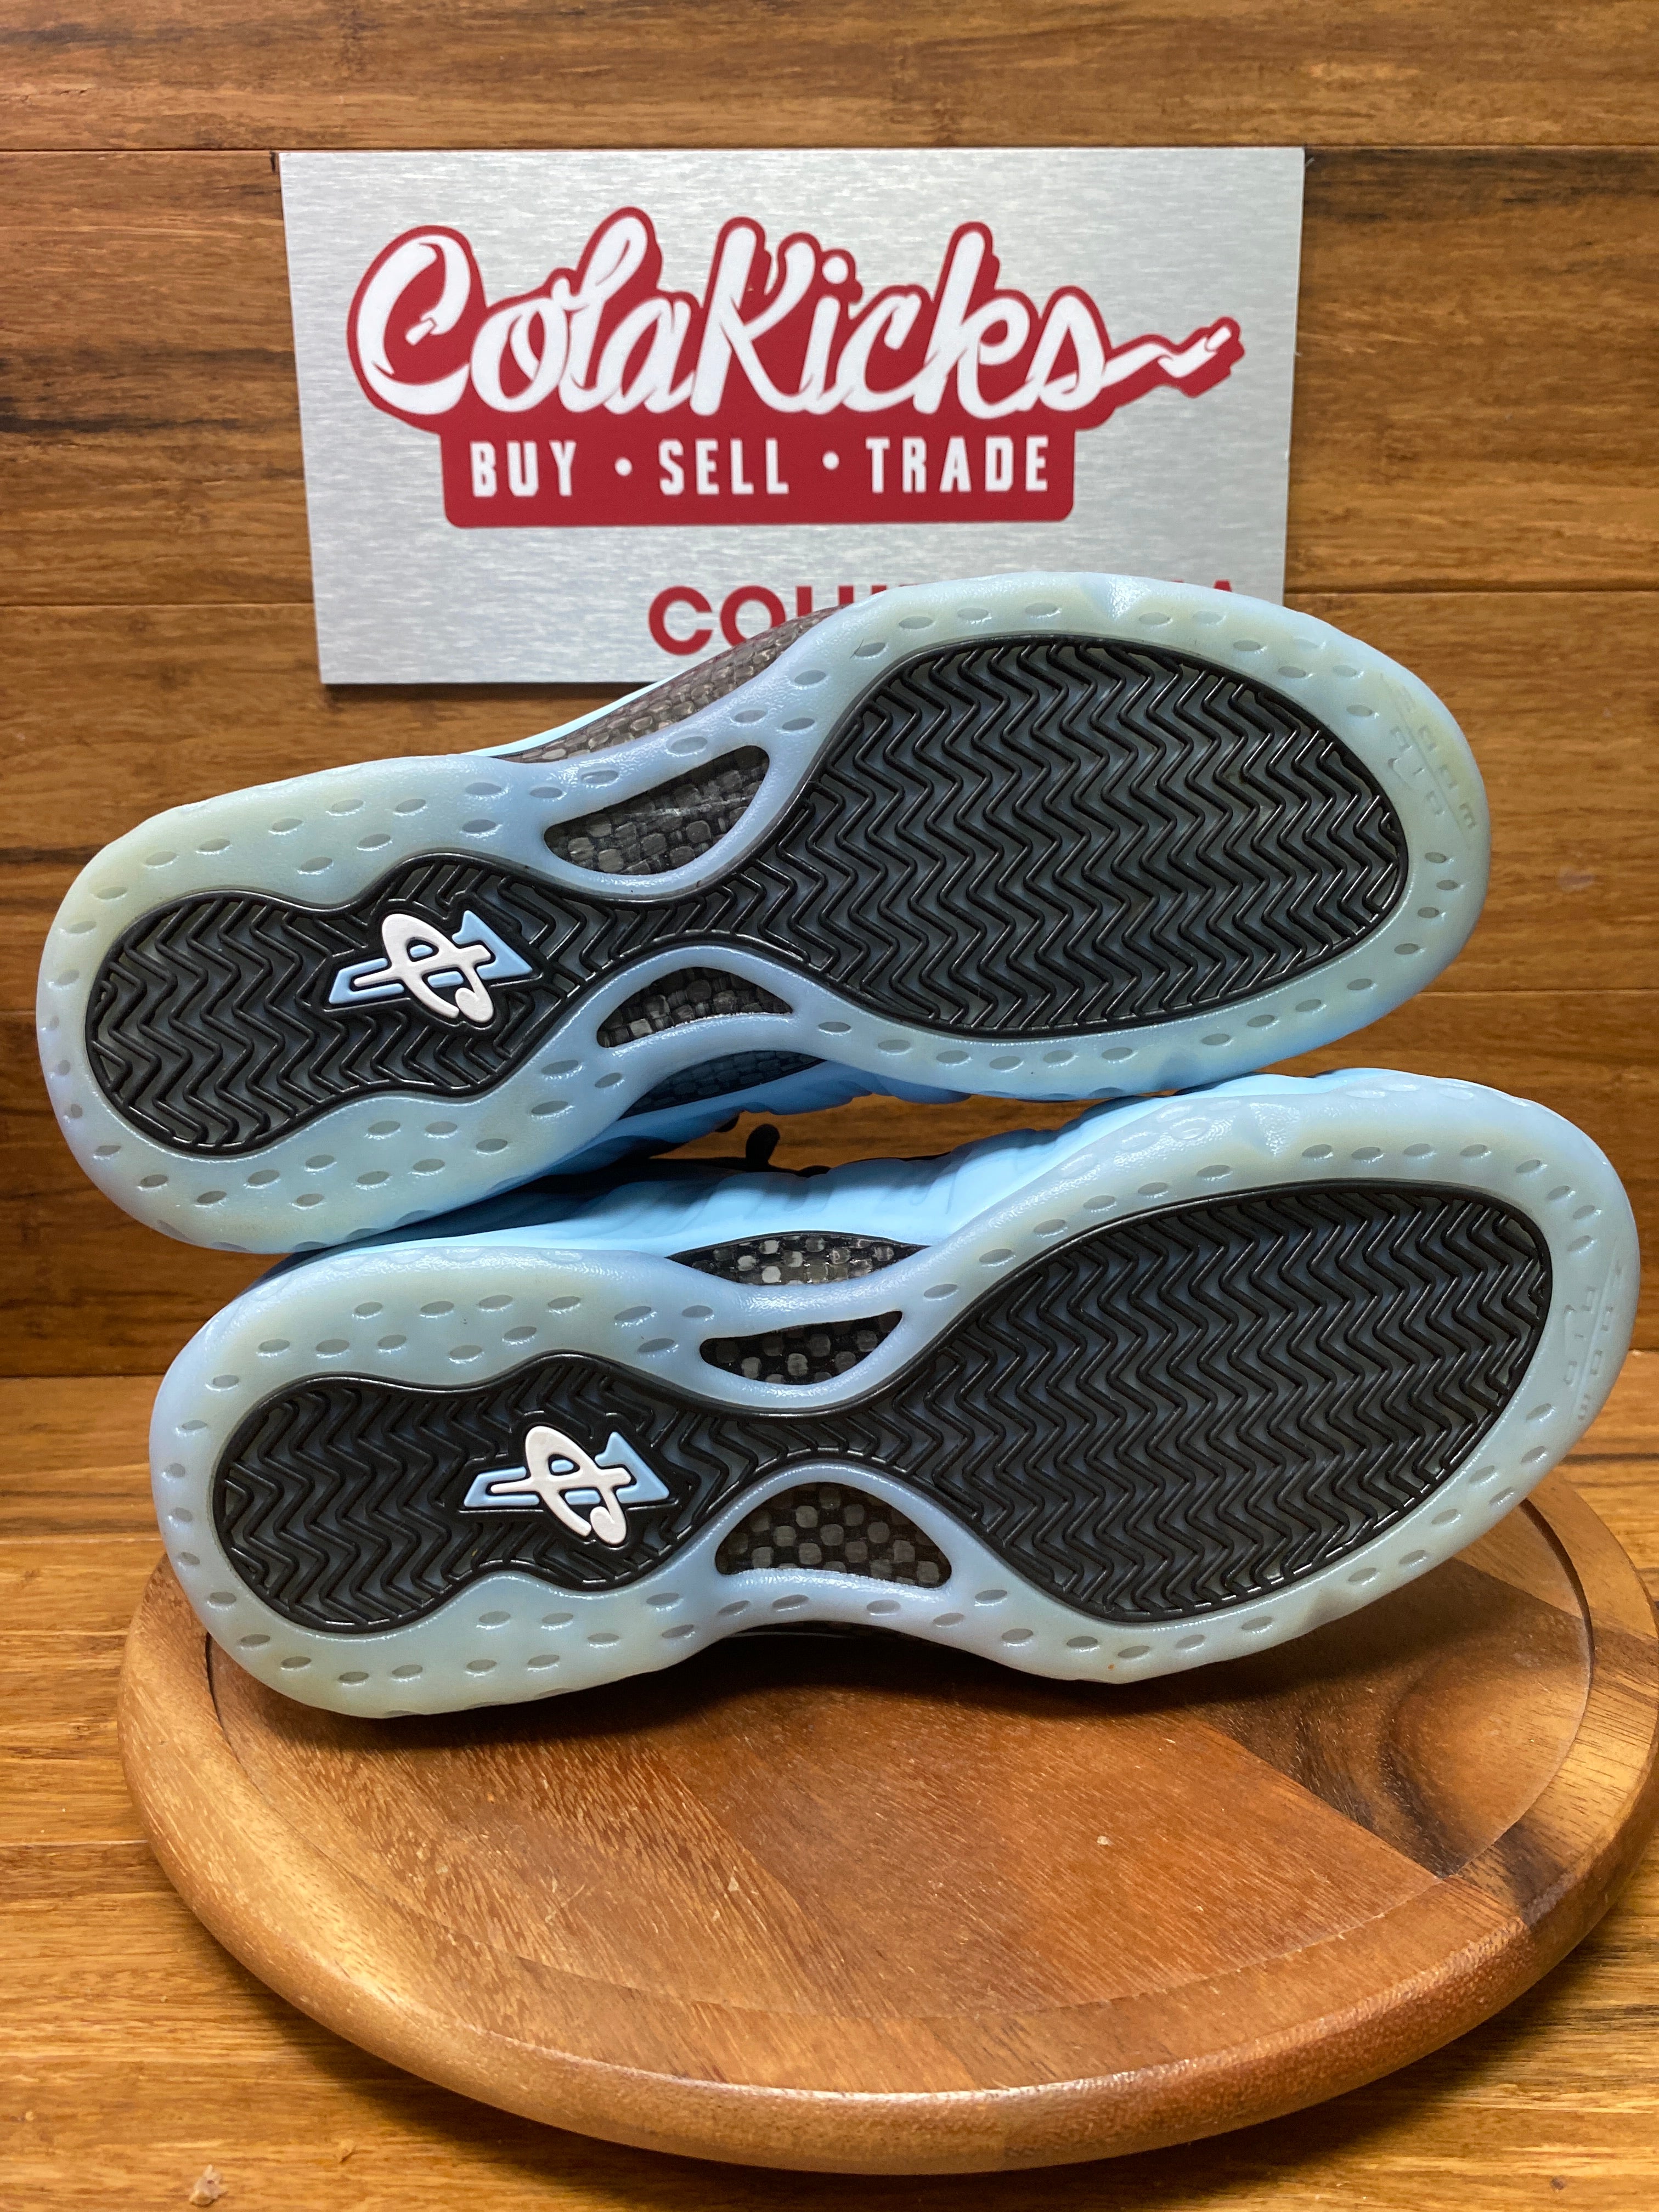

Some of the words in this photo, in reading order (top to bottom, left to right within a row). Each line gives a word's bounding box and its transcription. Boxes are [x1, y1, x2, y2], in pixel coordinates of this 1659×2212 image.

[354, 214, 1234, 419] ColaKicks
[471, 441, 577, 497] BUY
[659, 439, 789, 495] SELL
[865, 436, 1048, 493] TRADE
